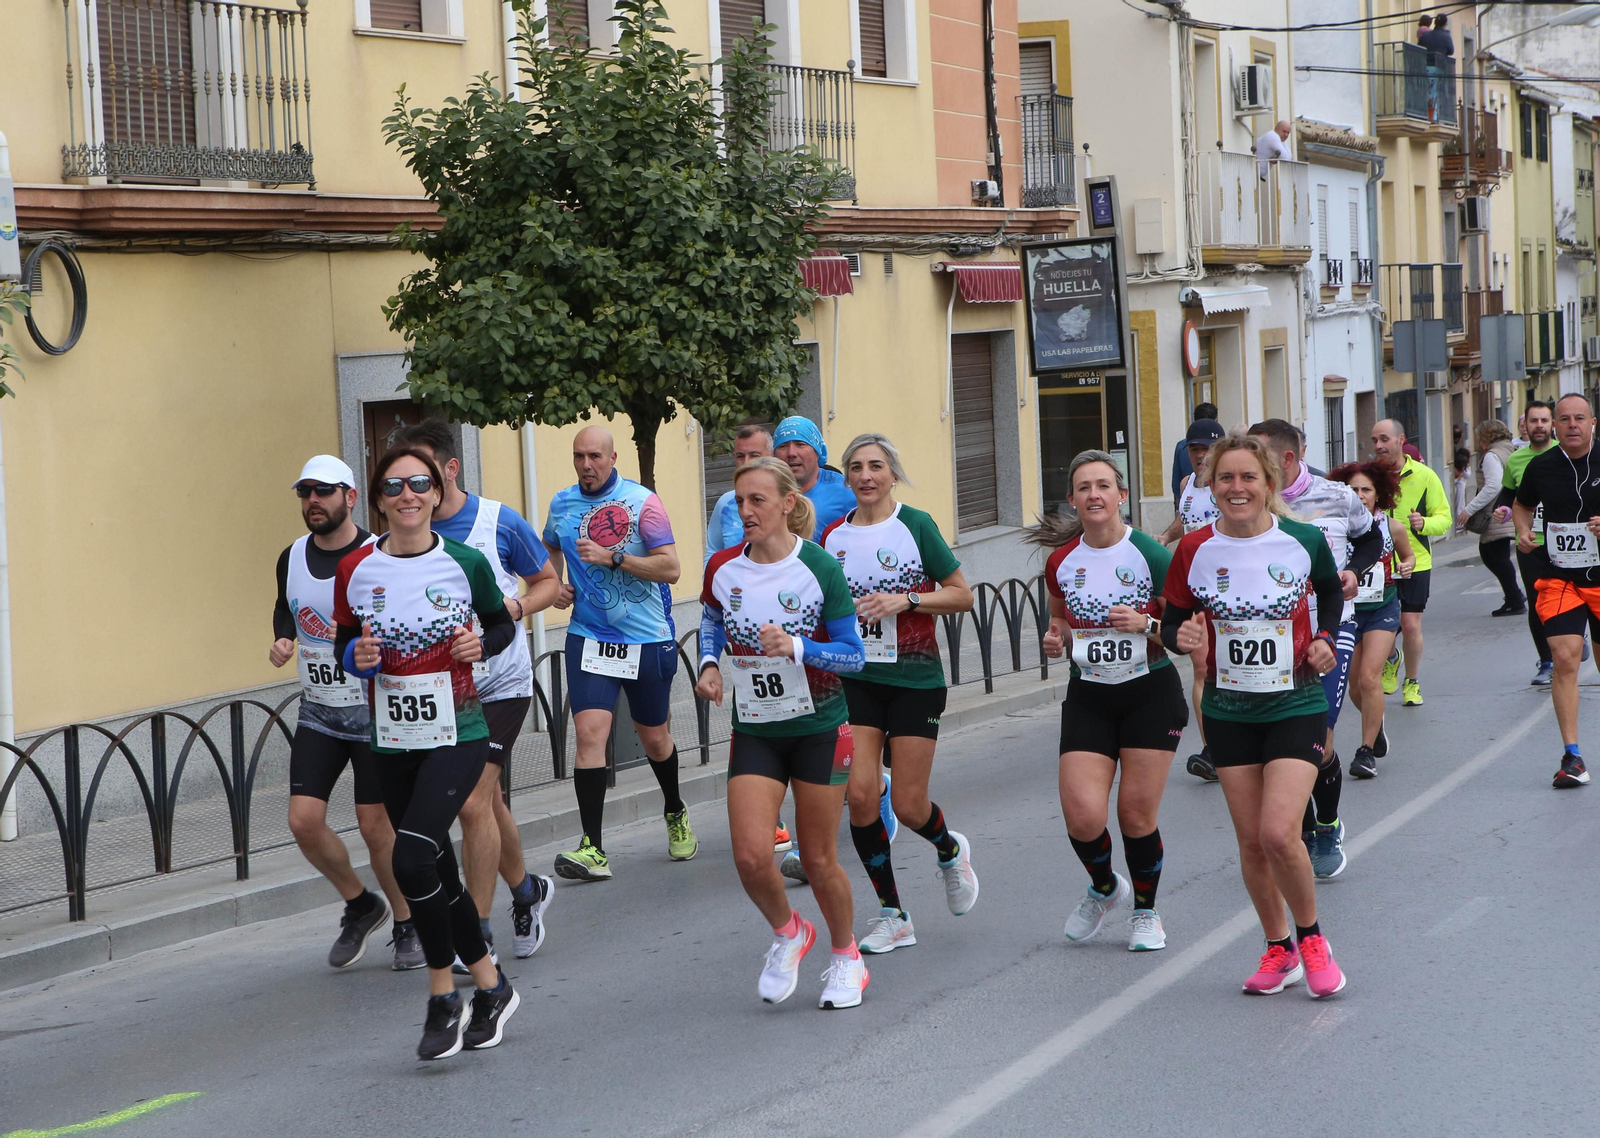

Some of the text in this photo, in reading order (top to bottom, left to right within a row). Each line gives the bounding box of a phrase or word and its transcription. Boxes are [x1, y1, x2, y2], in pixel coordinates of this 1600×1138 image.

[1098, 194, 1105, 204] 2
[1050, 271, 1060, 279] NO
[1062, 270, 1082, 278] DEJES
[1043, 279, 1102, 296] HUELLA
[1042, 349, 1056, 357] USA
[1072, 344, 1114, 354] PAPELERAS
[1556, 534, 1586, 552] 922
[596, 640, 628, 660] 168
[820, 650, 862, 662] SKYRACE
[1087, 639, 1133, 664] 636
[1228, 638, 1277, 666] 620
[307, 662, 346, 686] 564
[751, 672, 785, 699] 58
[387, 694, 438, 722] 535
